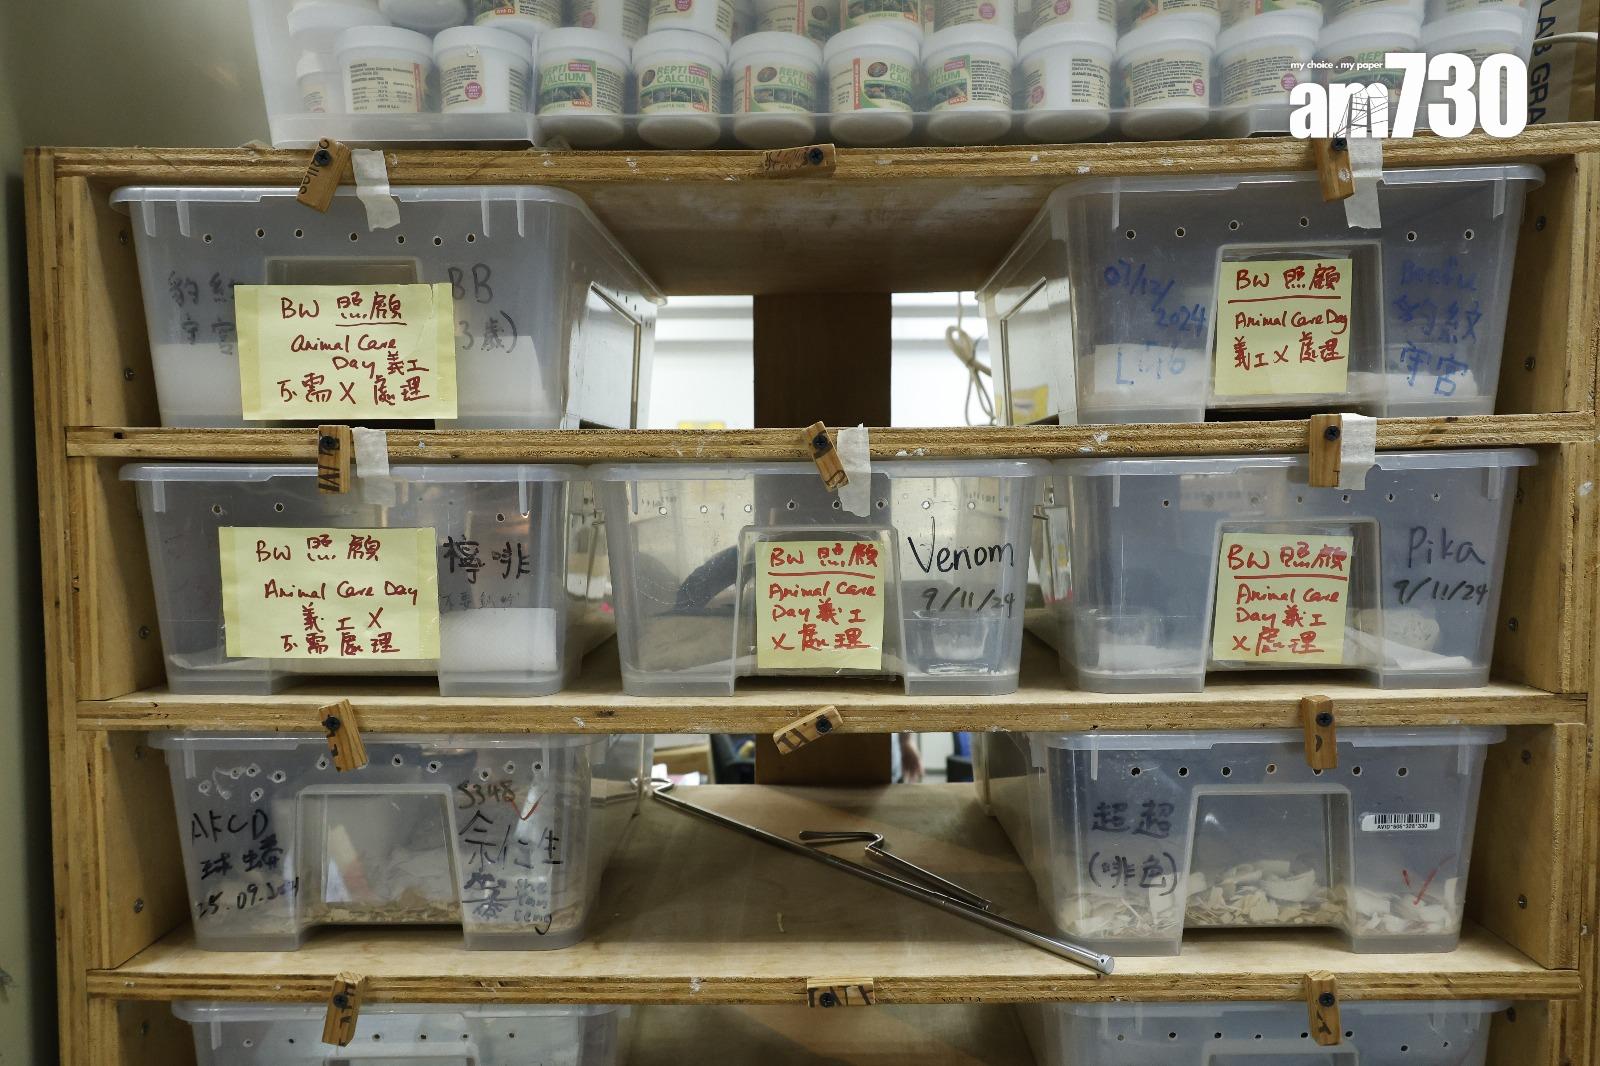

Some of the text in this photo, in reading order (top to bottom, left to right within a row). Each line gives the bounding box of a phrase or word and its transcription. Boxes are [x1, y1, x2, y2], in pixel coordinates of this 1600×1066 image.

[656, 65, 688, 75] REPTI
[656, 74, 705, 87] CALCIUM
[447, 264, 494, 304] BB
[1236, 262, 1342, 291] BW 照顧
[281, 291, 402, 320] BW 照顧
[1156, 302, 1206, 338] 2024
[1235, 310, 1349, 335] Animal Care Day
[291, 334, 399, 353] Animal Care
[332, 351, 430, 379] Day 義工
[256, 534, 381, 562] BW 照顧
[769, 542, 880, 568] BW 照顧
[907, 516, 1014, 573] Venom
[1227, 541, 1348, 572] BW 照顧
[1408, 526, 1486, 569] Pika
[443, 534, 530, 584] 檸啡
[264, 579, 326, 600] Animal
[336, 580, 375, 599] Care
[384, 580, 418, 606] Day
[769, 580, 877, 600] Animal Care
[922, 587, 1016, 618] 9/11/24
[1235, 584, 1340, 605] Animal Care
[772, 604, 811, 622] Day
[1235, 607, 1276, 626] Day
[1091, 800, 1176, 839] 超超
